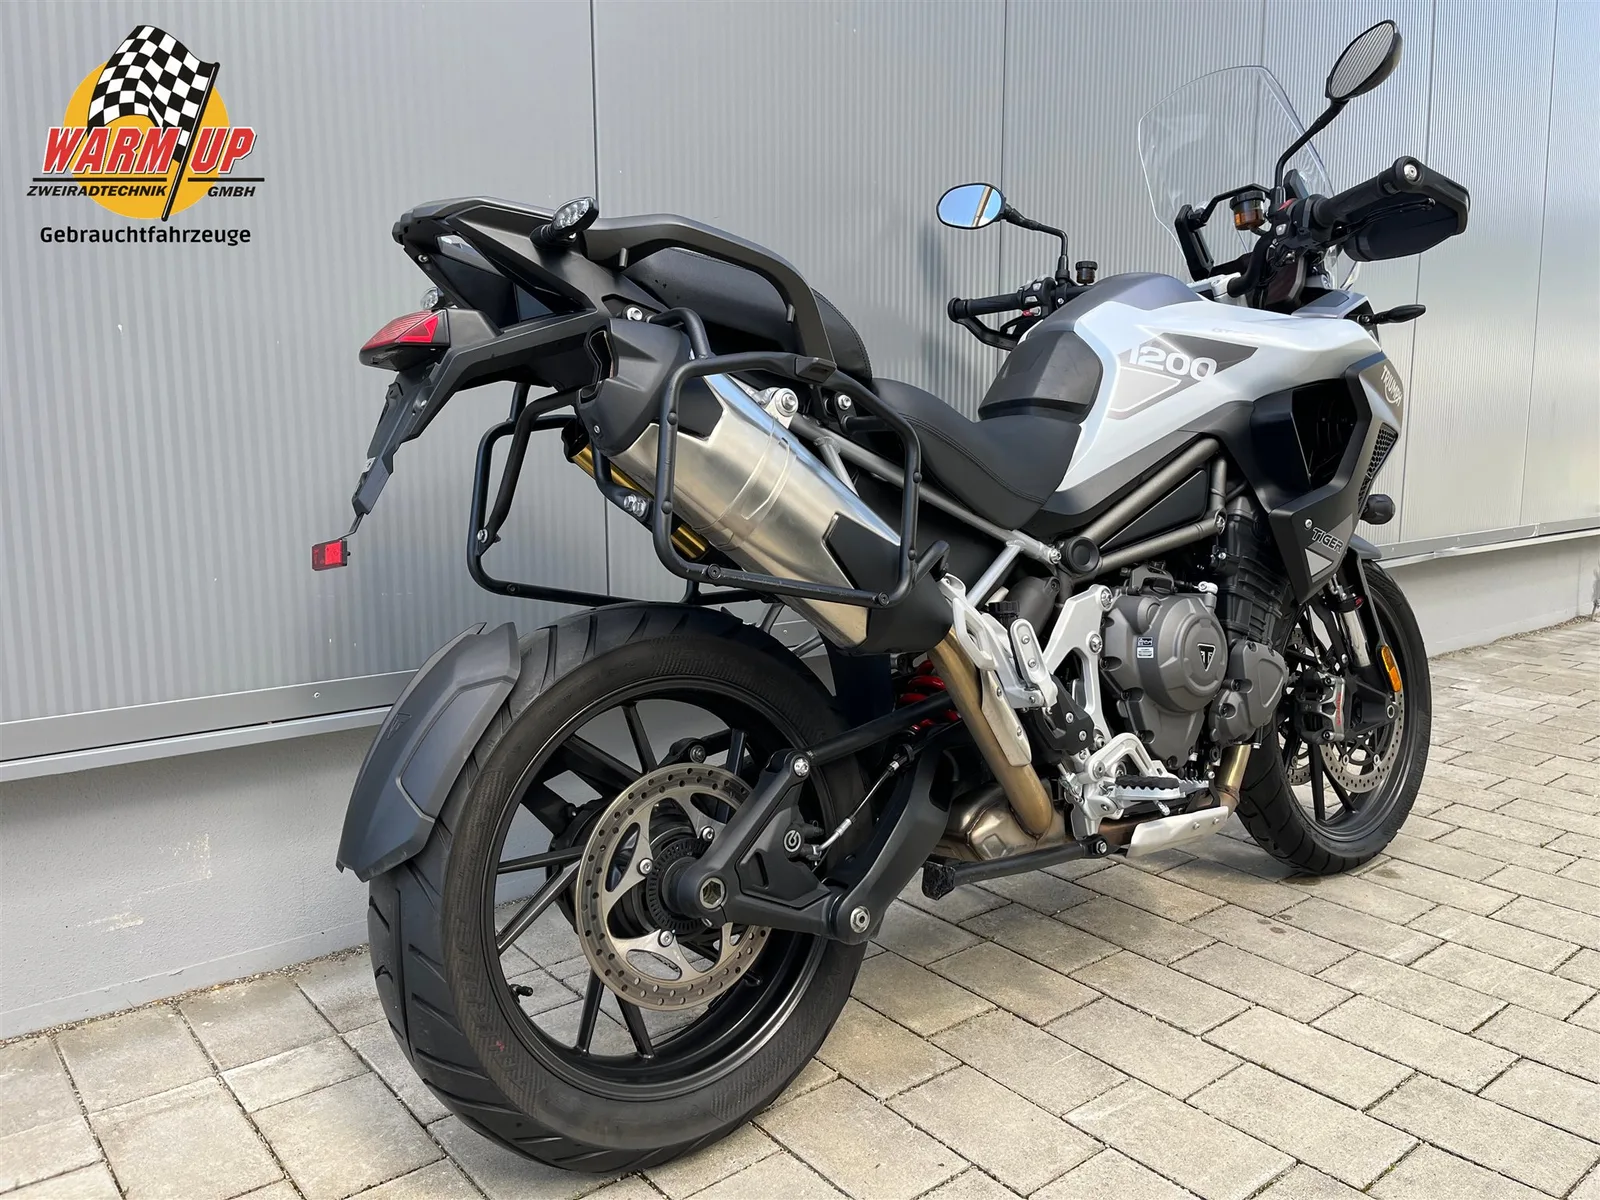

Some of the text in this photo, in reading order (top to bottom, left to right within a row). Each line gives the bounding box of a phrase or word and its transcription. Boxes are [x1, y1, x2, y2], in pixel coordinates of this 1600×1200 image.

[1129, 344, 1218, 382] 1200
[1380, 365, 1403, 407] TRIUMPH
[1311, 527, 1345, 555] TIGER
